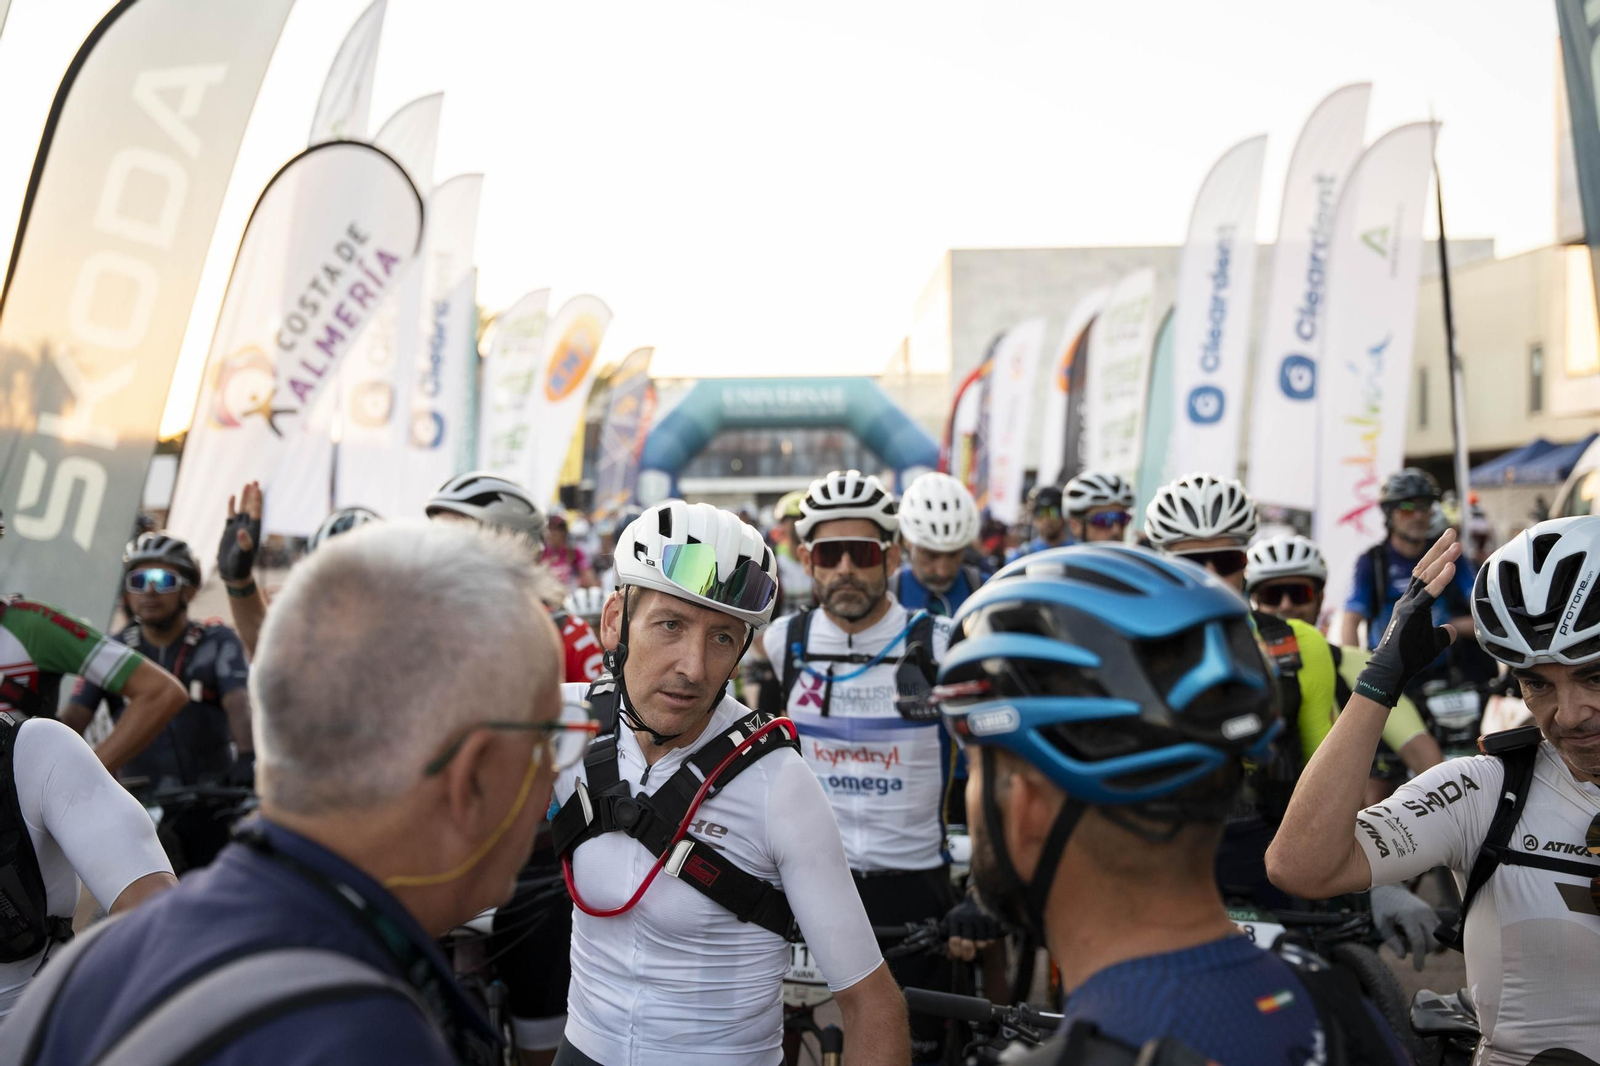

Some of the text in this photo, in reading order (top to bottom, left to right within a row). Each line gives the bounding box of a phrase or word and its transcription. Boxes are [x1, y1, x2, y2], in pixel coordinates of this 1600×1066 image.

[277, 221, 370, 352] COSTA DE
[286, 249, 400, 404] ALMERÍA
[813, 742, 900, 771] kyndryl
[829, 775, 903, 795] omega
